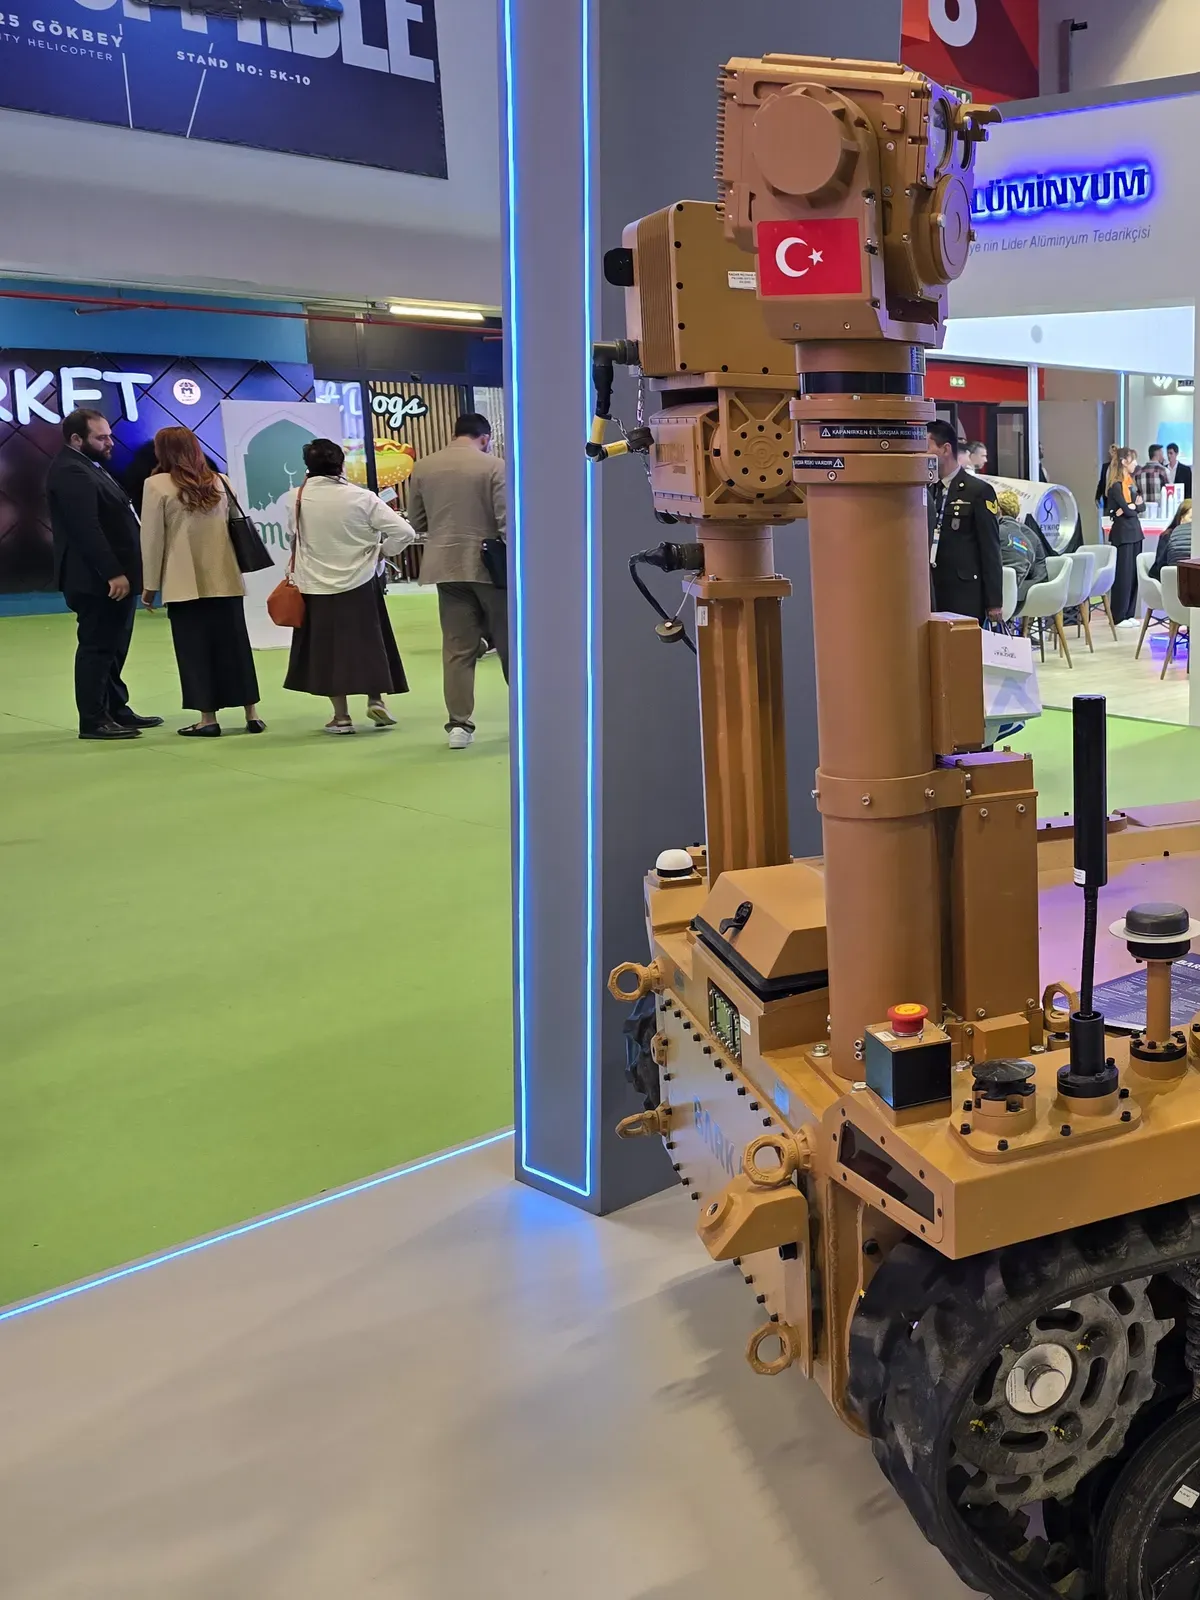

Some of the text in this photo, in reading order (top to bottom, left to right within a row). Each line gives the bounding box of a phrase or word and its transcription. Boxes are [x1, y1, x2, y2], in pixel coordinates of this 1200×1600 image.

[32, 19, 123, 48] GÖKBEY
[28, 38, 113, 62] HELICOPTER
[176, 50, 311, 86] STAND NO: 5K-10
[971, 169, 1146, 214] LÜMİNYUM
[983, 241, 998, 252] nin
[1001, 237, 1027, 251] Lider
[1029, 232, 1088, 249] Alüminyum
[1093, 225, 1151, 244] Tedarikçisi
